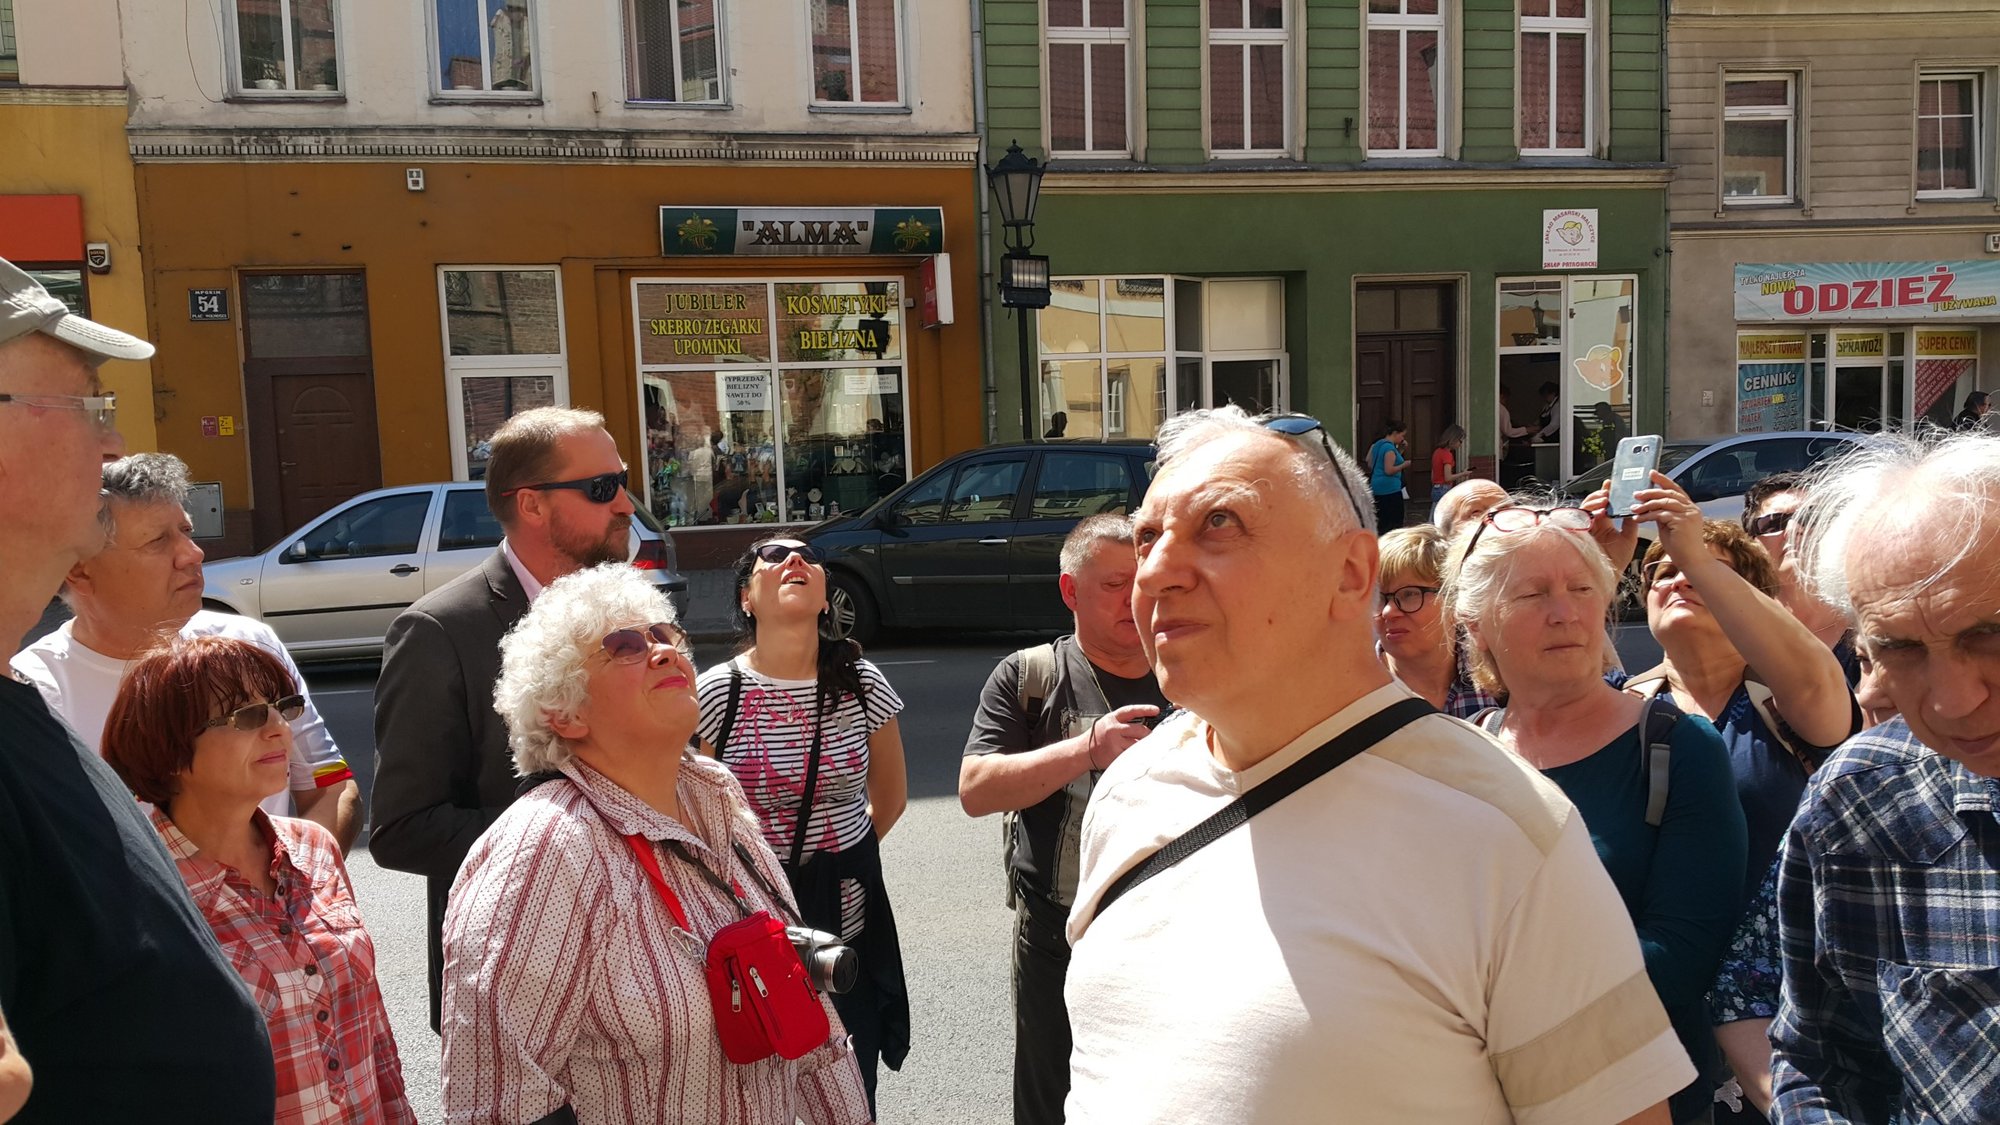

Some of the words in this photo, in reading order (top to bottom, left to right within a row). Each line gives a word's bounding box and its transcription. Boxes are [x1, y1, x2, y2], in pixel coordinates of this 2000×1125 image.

[742, 220, 869, 246] "ALMA"
[1741, 274, 1763, 286] TYLKO
[1764, 268, 1806, 282] NAJLEPSZA
[1761, 278, 1796, 296] NOWA
[1783, 265, 1957, 316] ODZIEŻ
[198, 296, 219, 312] 54
[664, 294, 747, 314] JUBILER
[786, 294, 888, 316] KOSMETYKI
[650, 318, 702, 336] SREBRO
[704, 318, 762, 335] ZEGARKI
[673, 338, 742, 356] UPOMINKI
[800, 328, 878, 350] BIELIZNA
[1918, 336, 1947, 350] SUPER
[1949, 336, 1975, 350] CENY!
[1740, 340, 1778, 357] NAJLEPSZY
[1779, 340, 1803, 354] TOWAR
[1744, 371, 1796, 392] CENNIK:
